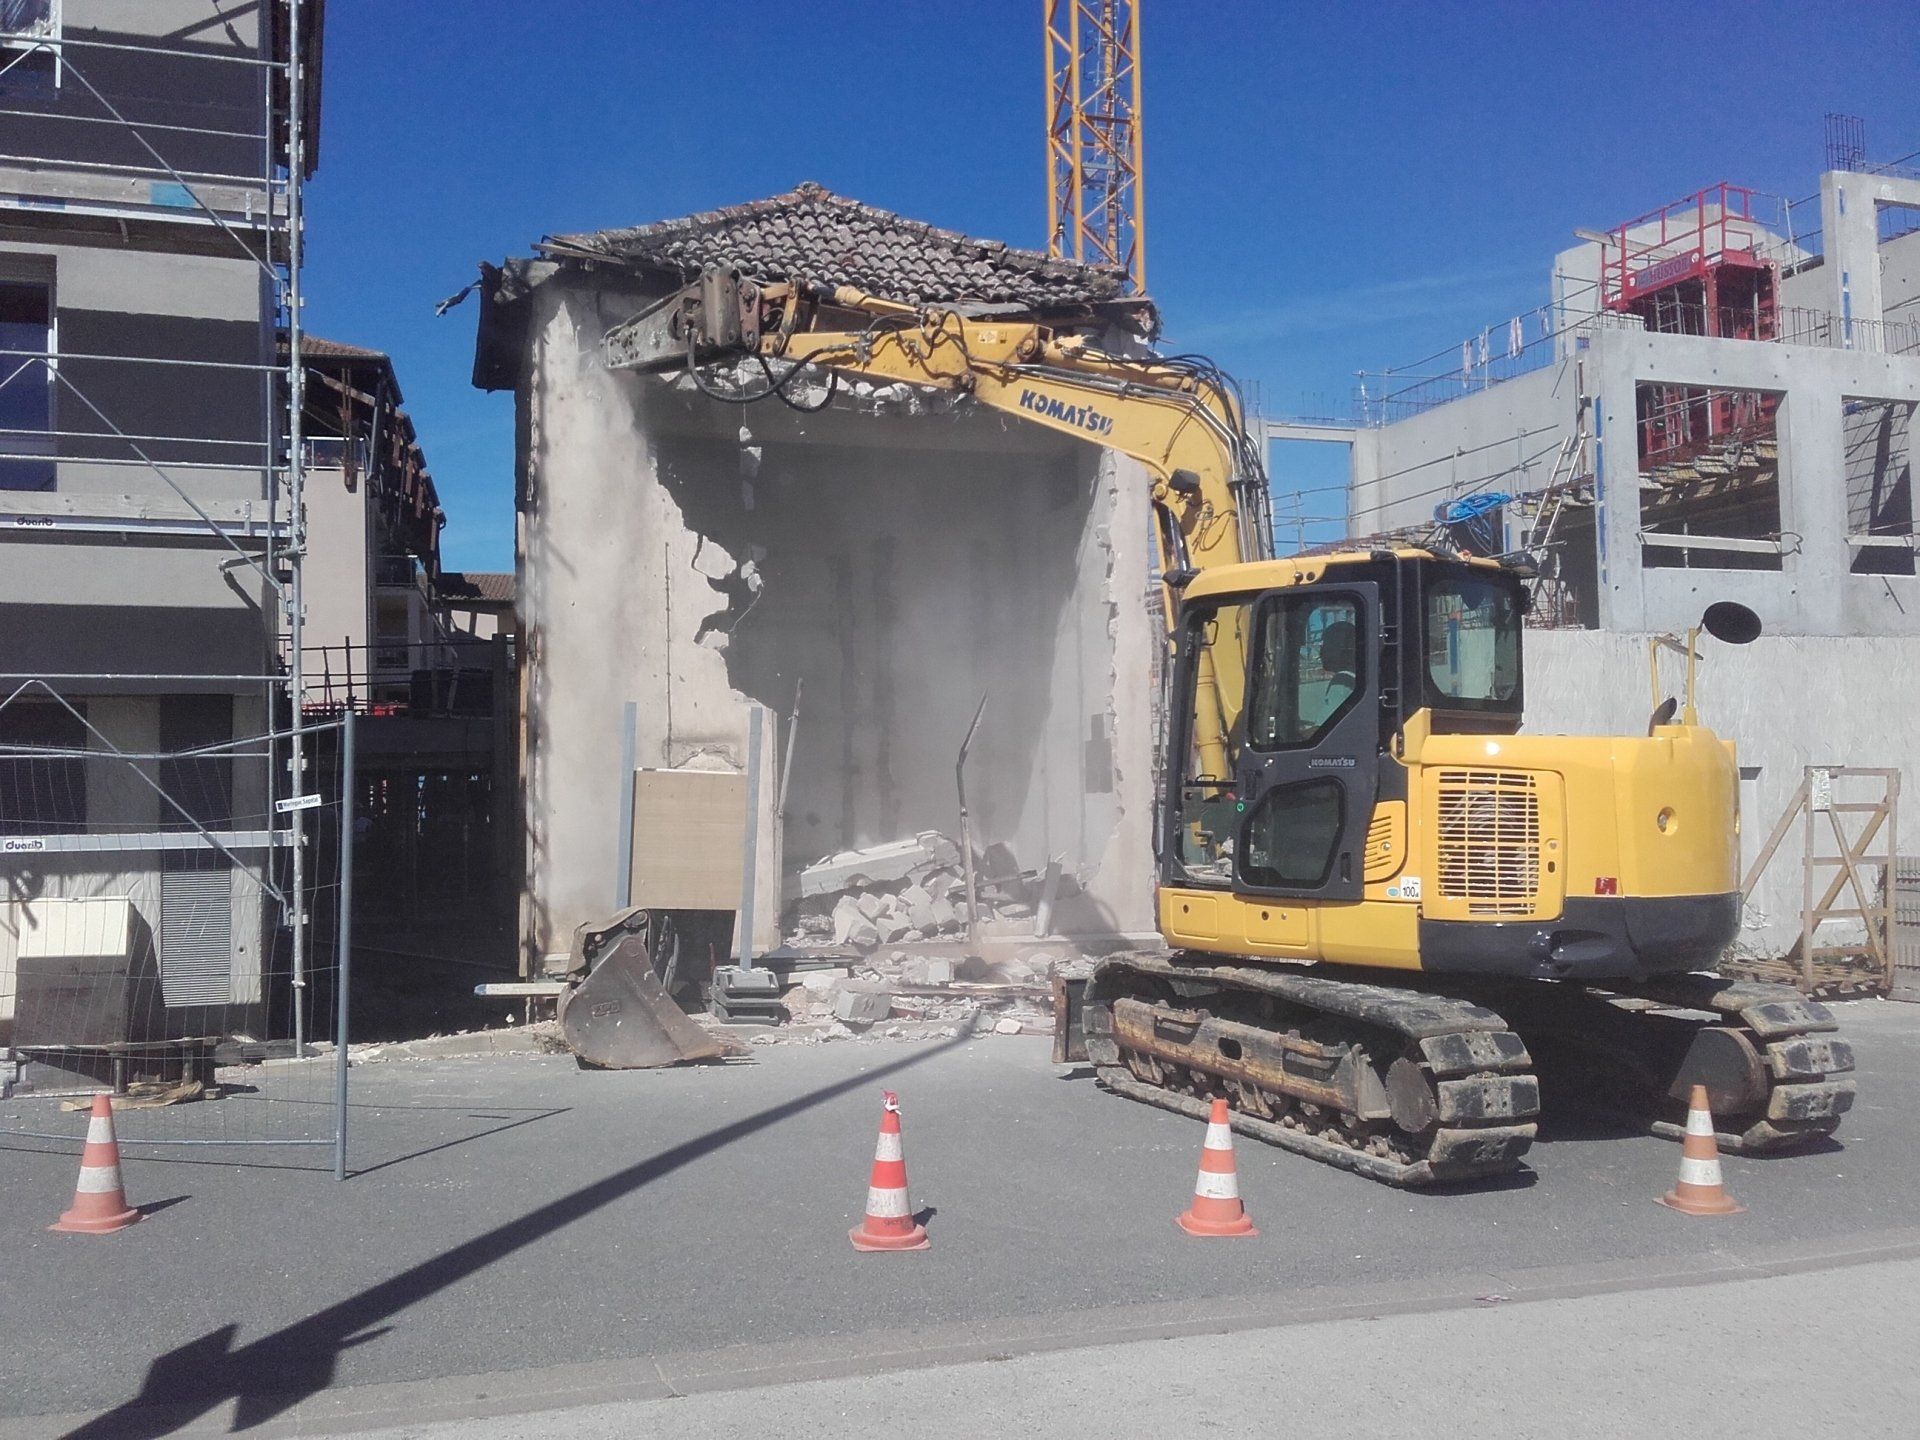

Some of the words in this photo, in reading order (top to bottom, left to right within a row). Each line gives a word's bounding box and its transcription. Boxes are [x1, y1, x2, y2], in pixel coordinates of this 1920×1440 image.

[1020, 389, 1113, 435] KOMATSU
[1311, 757, 1355, 766] KOMATSU
[6, 840, 42, 849] duarib
